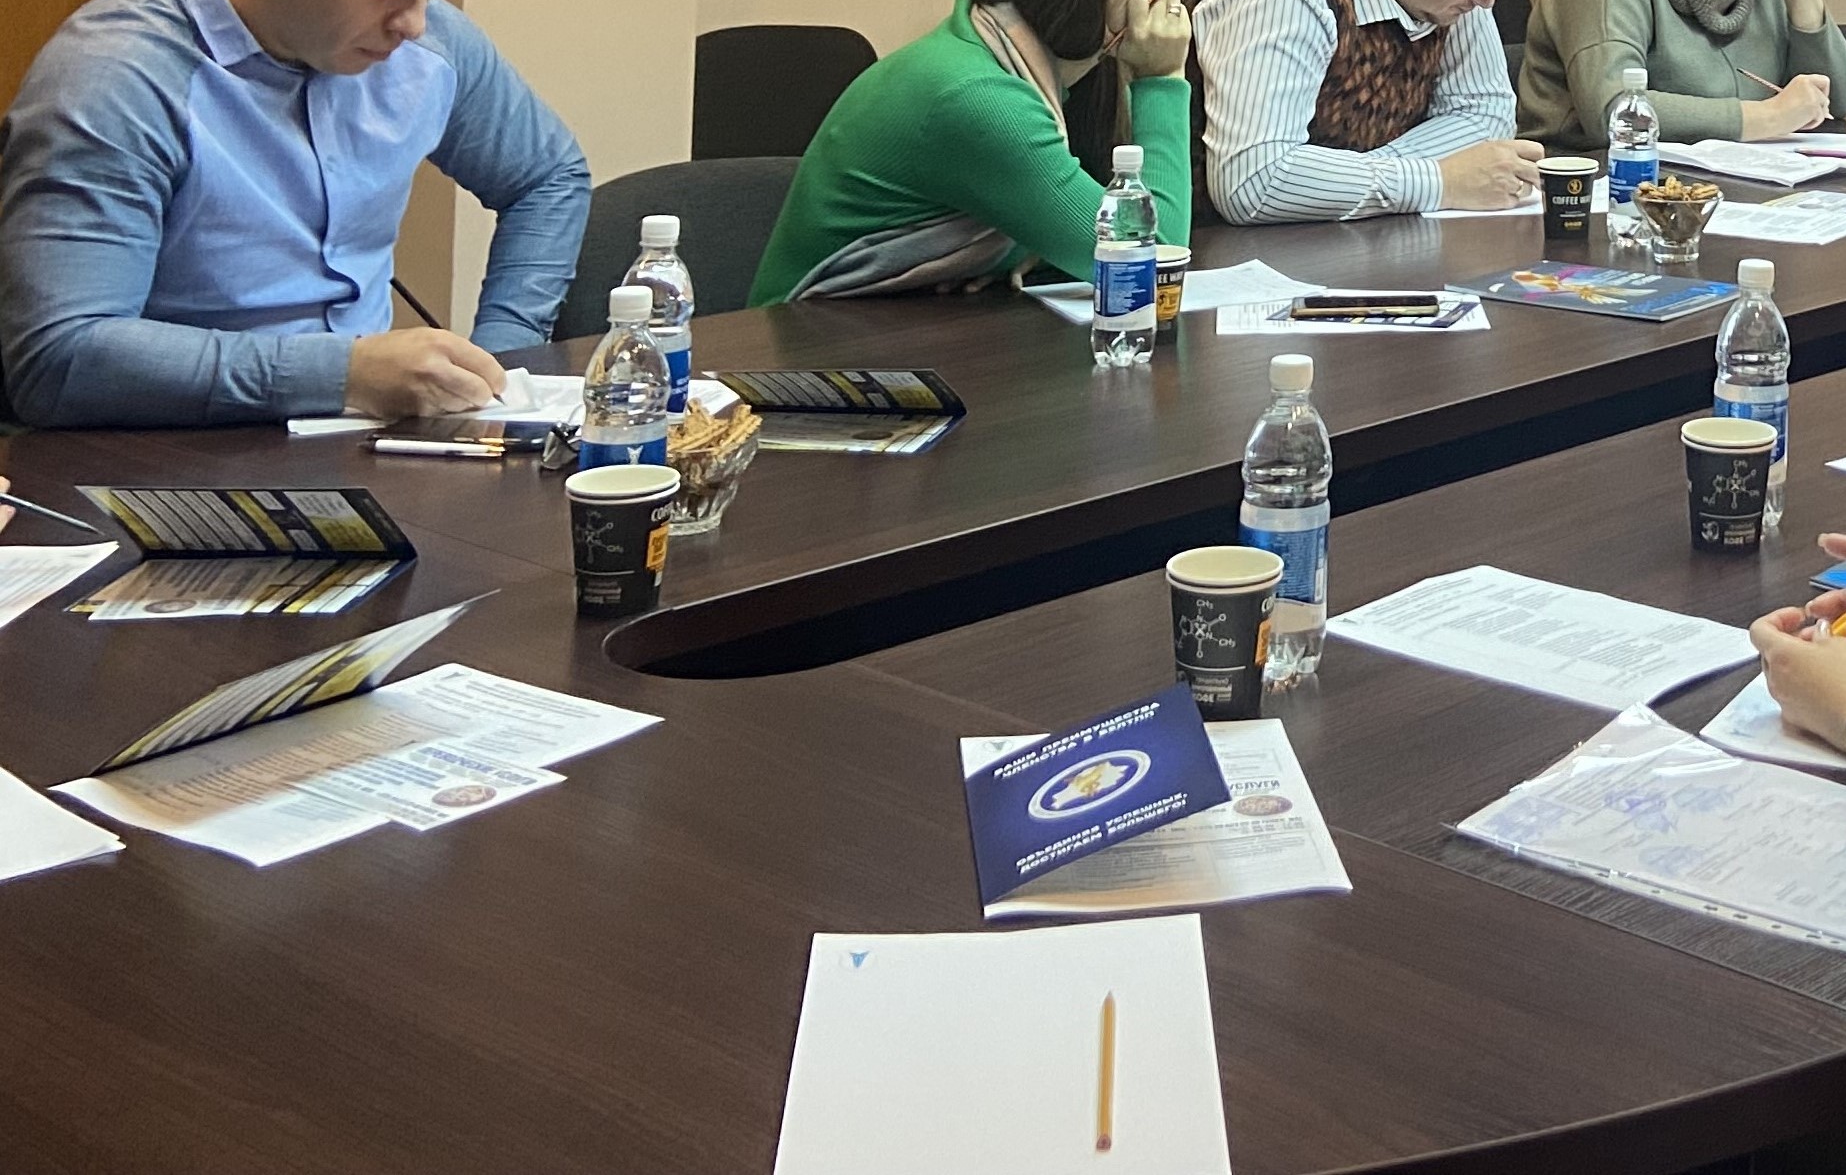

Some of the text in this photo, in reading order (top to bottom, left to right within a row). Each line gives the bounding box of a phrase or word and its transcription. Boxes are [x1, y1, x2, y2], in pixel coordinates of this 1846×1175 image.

[1552, 196, 1579, 205] COFFEE
[994, 702, 1160, 777] ВАШИ ПРЕИМУЩЕСТВА
[1002, 741, 1077, 778] ЧЛЕНСТВА
[1016, 792, 1188, 868] ОБЪЕДИНЯЯ УСПЕШНЫХ,
[1020, 798, 1187, 875] ДОСТИГАЕМ БОЛЬШЕГО!
